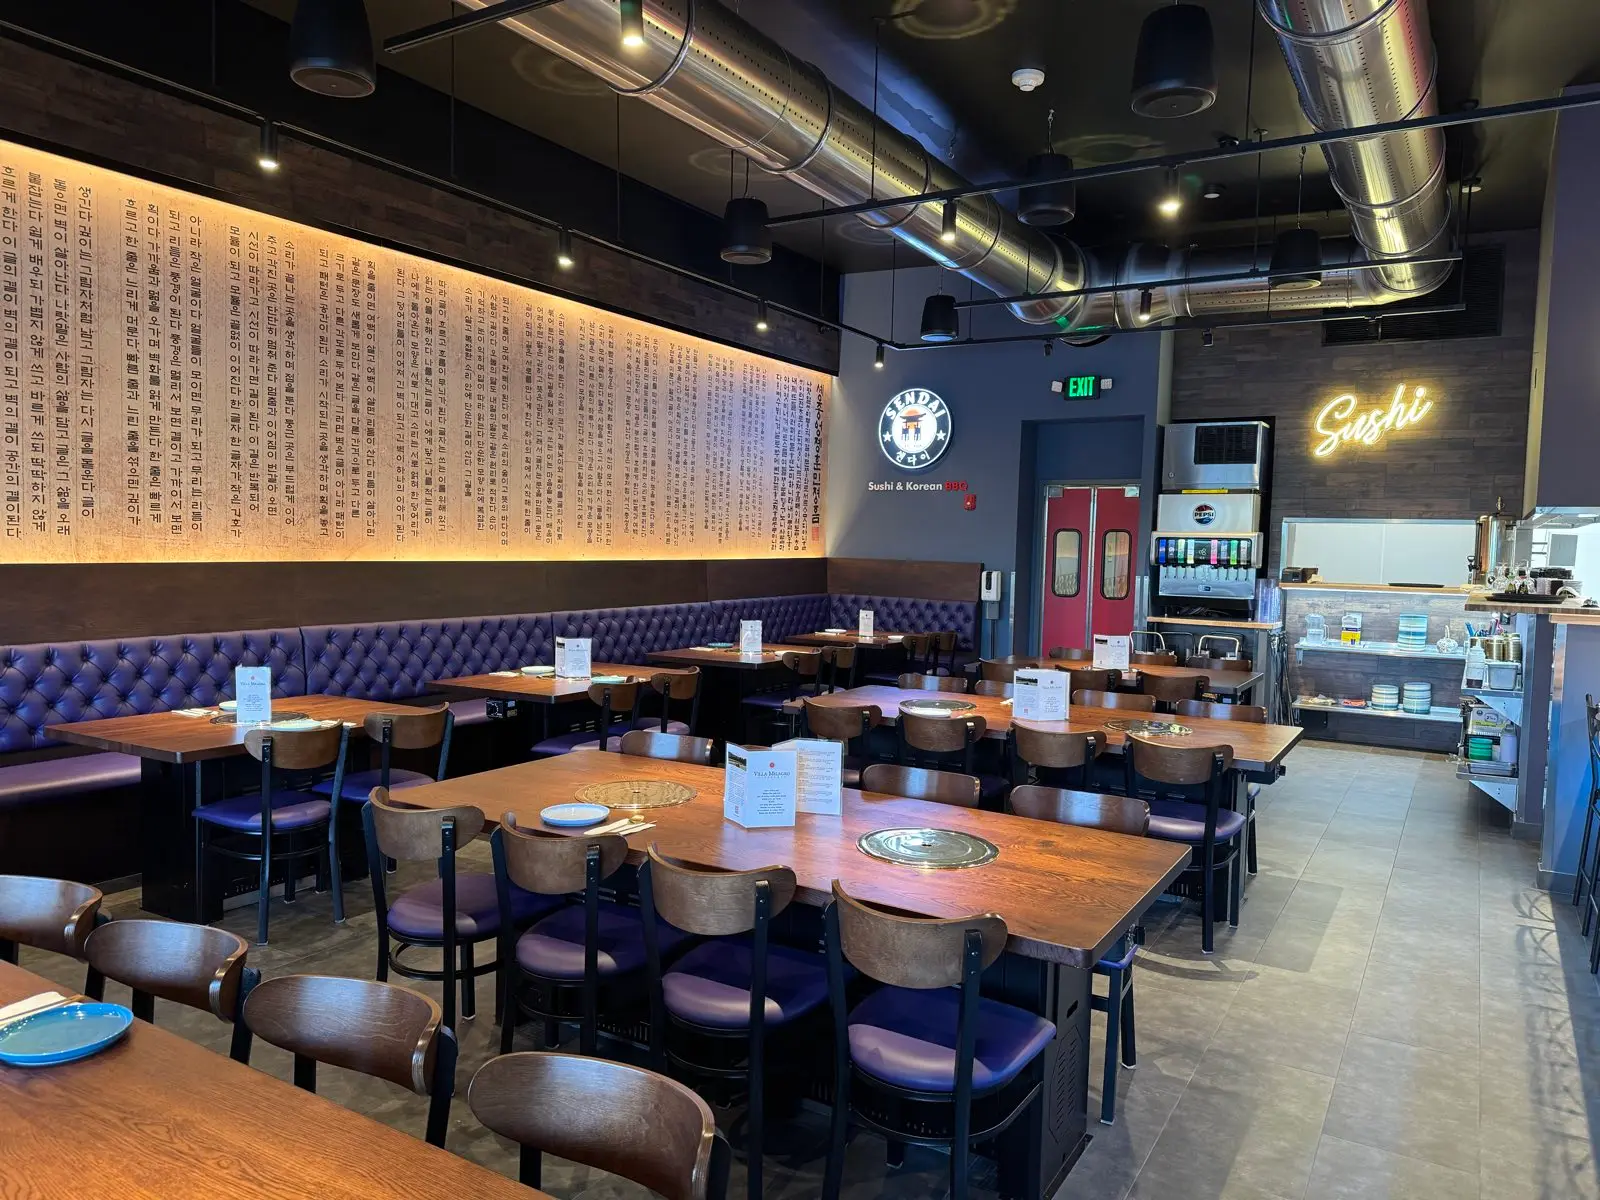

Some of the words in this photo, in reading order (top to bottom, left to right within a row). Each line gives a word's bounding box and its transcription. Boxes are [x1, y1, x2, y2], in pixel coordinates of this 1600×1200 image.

[1069, 376, 1095, 398] EXIT
[885, 391, 947, 420] SENDAI
[1314, 383, 1434, 457] Sushi
[868, 481, 894, 491] Sushi
[896, 481, 904, 491] &
[906, 481, 943, 491] Korean
[944, 480, 969, 491] BBQ
